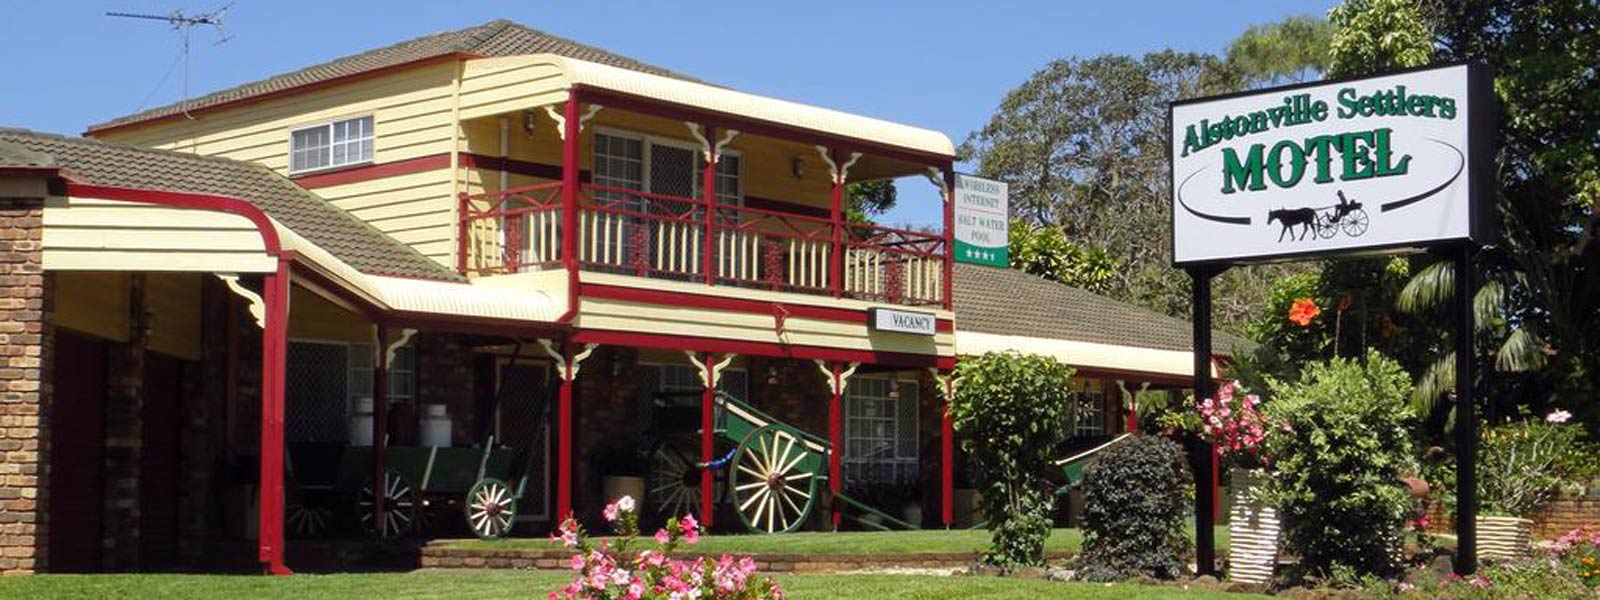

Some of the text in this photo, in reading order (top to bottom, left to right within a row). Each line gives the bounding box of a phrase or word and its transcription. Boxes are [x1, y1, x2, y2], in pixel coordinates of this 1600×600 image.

[1180, 85, 1457, 157] Alstonville Settlers
[1221, 127, 1412, 194] MOTEL
[962, 178, 1001, 194] WIRELESS
[963, 193, 1000, 208] INTERNET
[958, 214, 1005, 231] SALT WATER
[971, 230, 991, 243] POOL
[892, 313, 931, 330] VACANCY
